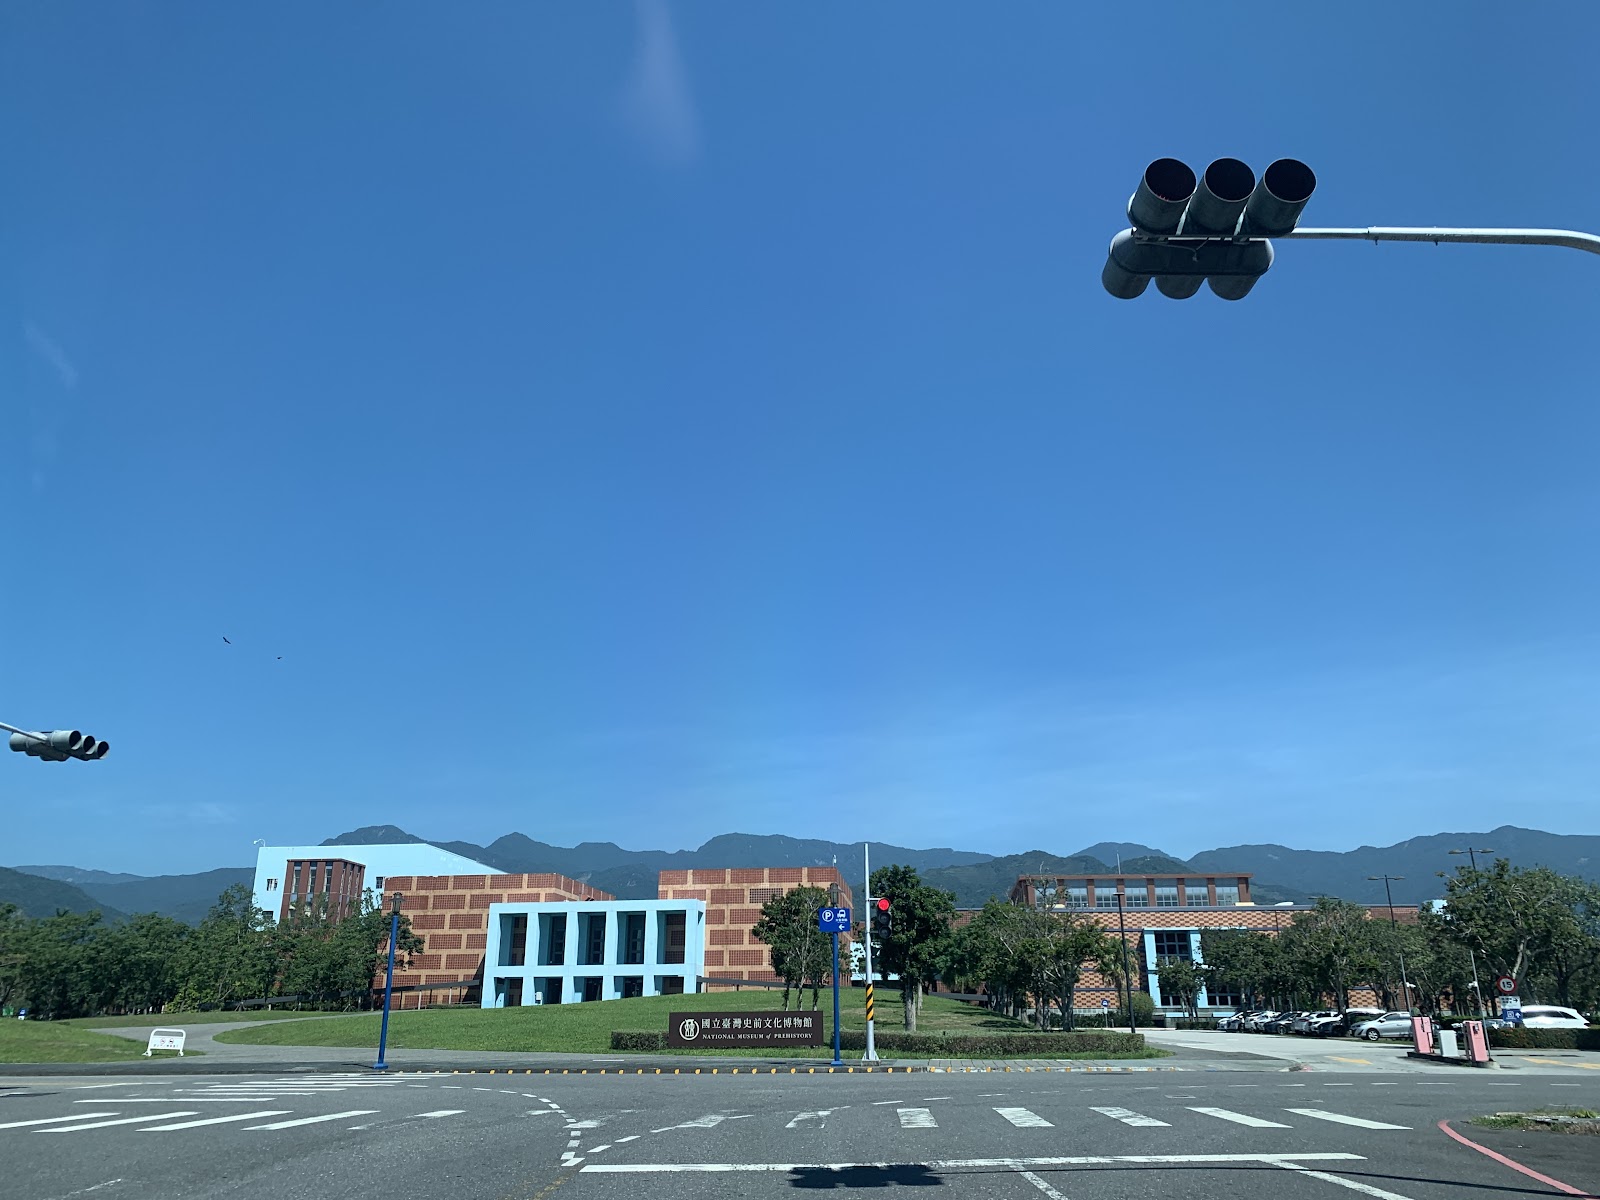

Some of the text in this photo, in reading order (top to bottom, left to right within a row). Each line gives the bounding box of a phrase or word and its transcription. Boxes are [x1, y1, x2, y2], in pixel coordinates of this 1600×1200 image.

[825, 911, 832, 920] P
[1501, 981, 1512, 989] 15
[701, 1018, 813, 1029] 國立臺灣史前文化博物館
